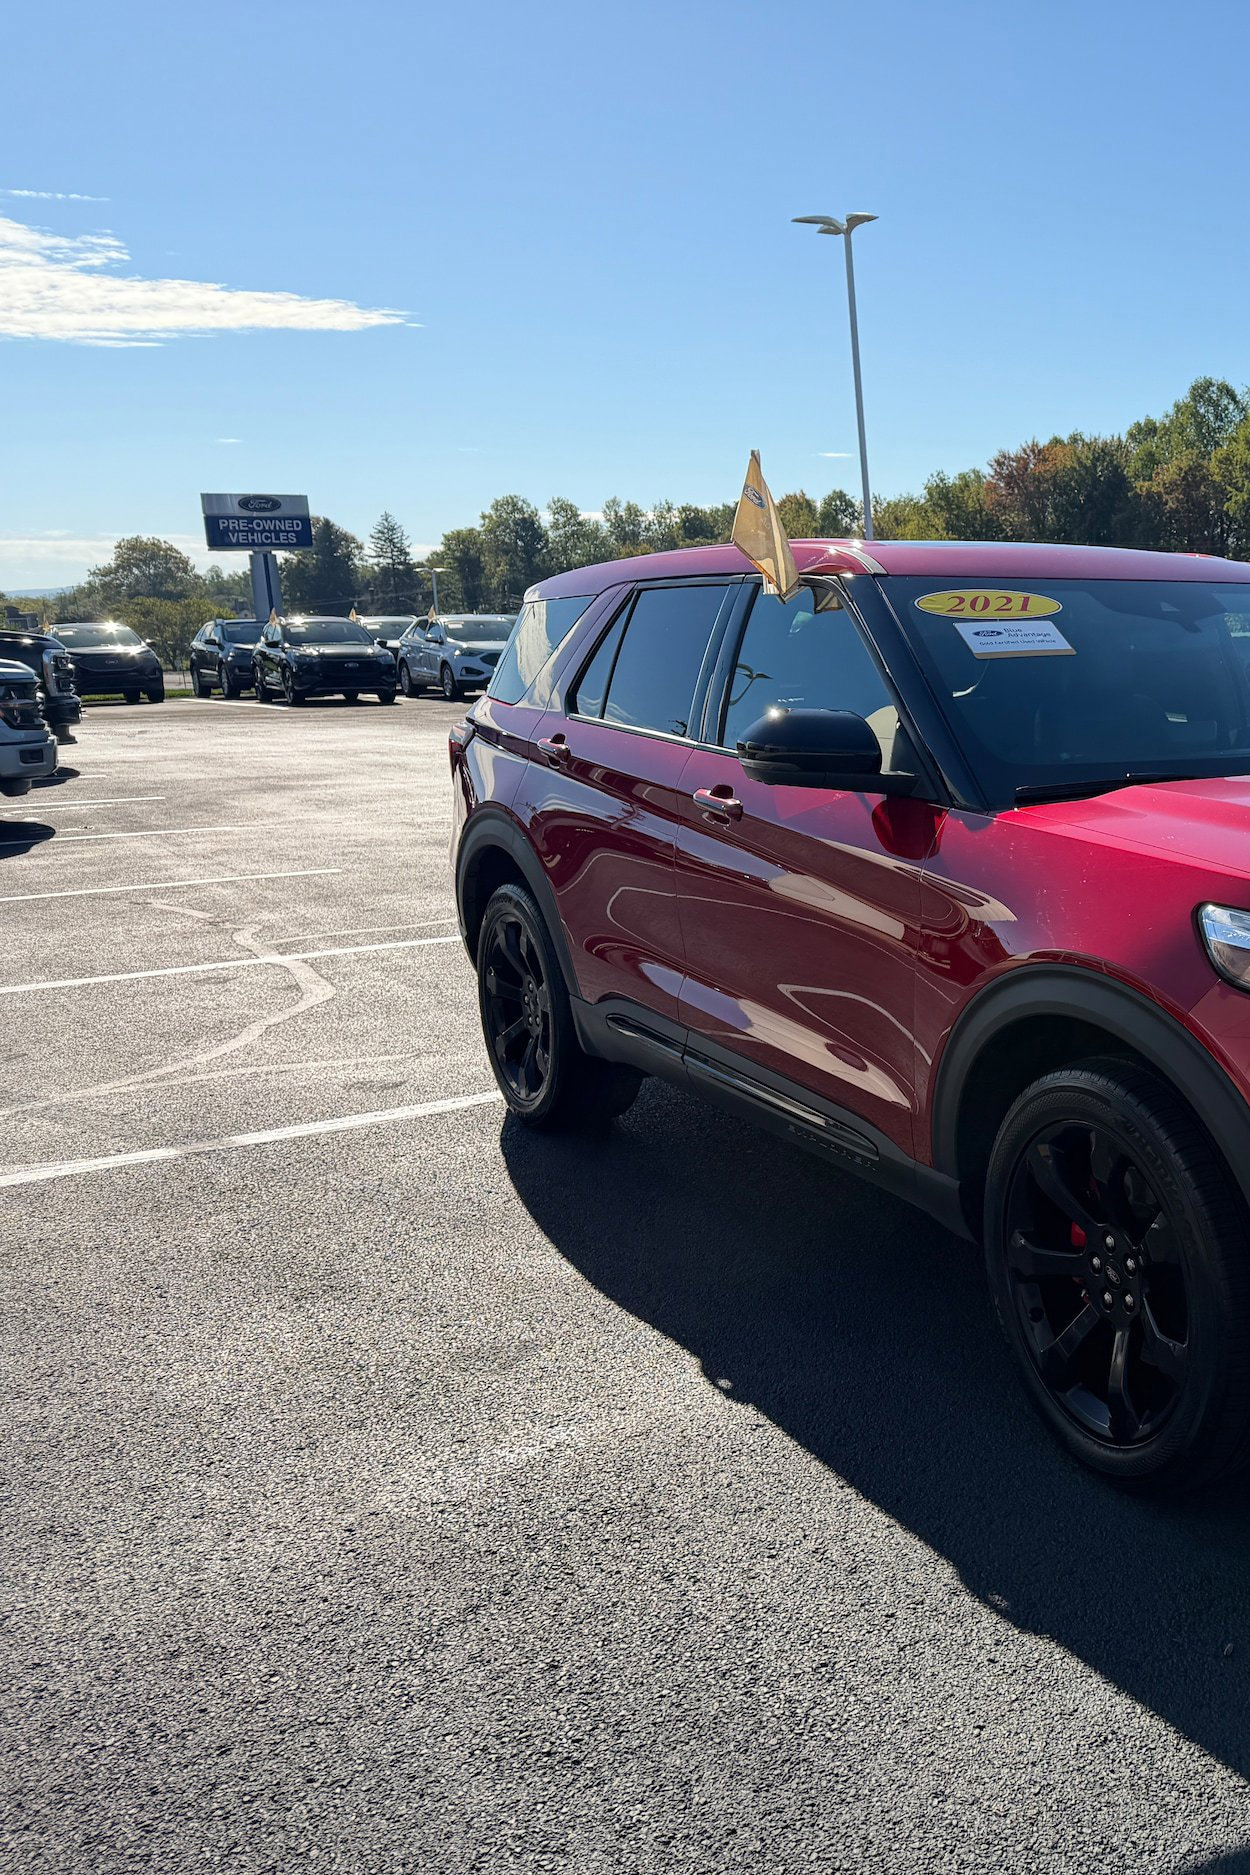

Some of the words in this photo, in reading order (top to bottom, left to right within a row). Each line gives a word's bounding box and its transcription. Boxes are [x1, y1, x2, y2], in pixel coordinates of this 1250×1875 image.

[247, 499, 273, 509] Ford
[218, 519, 303, 531] PRE-OWNED
[228, 532, 298, 544] VEHICLES
[945, 595, 1031, 613] 2021
